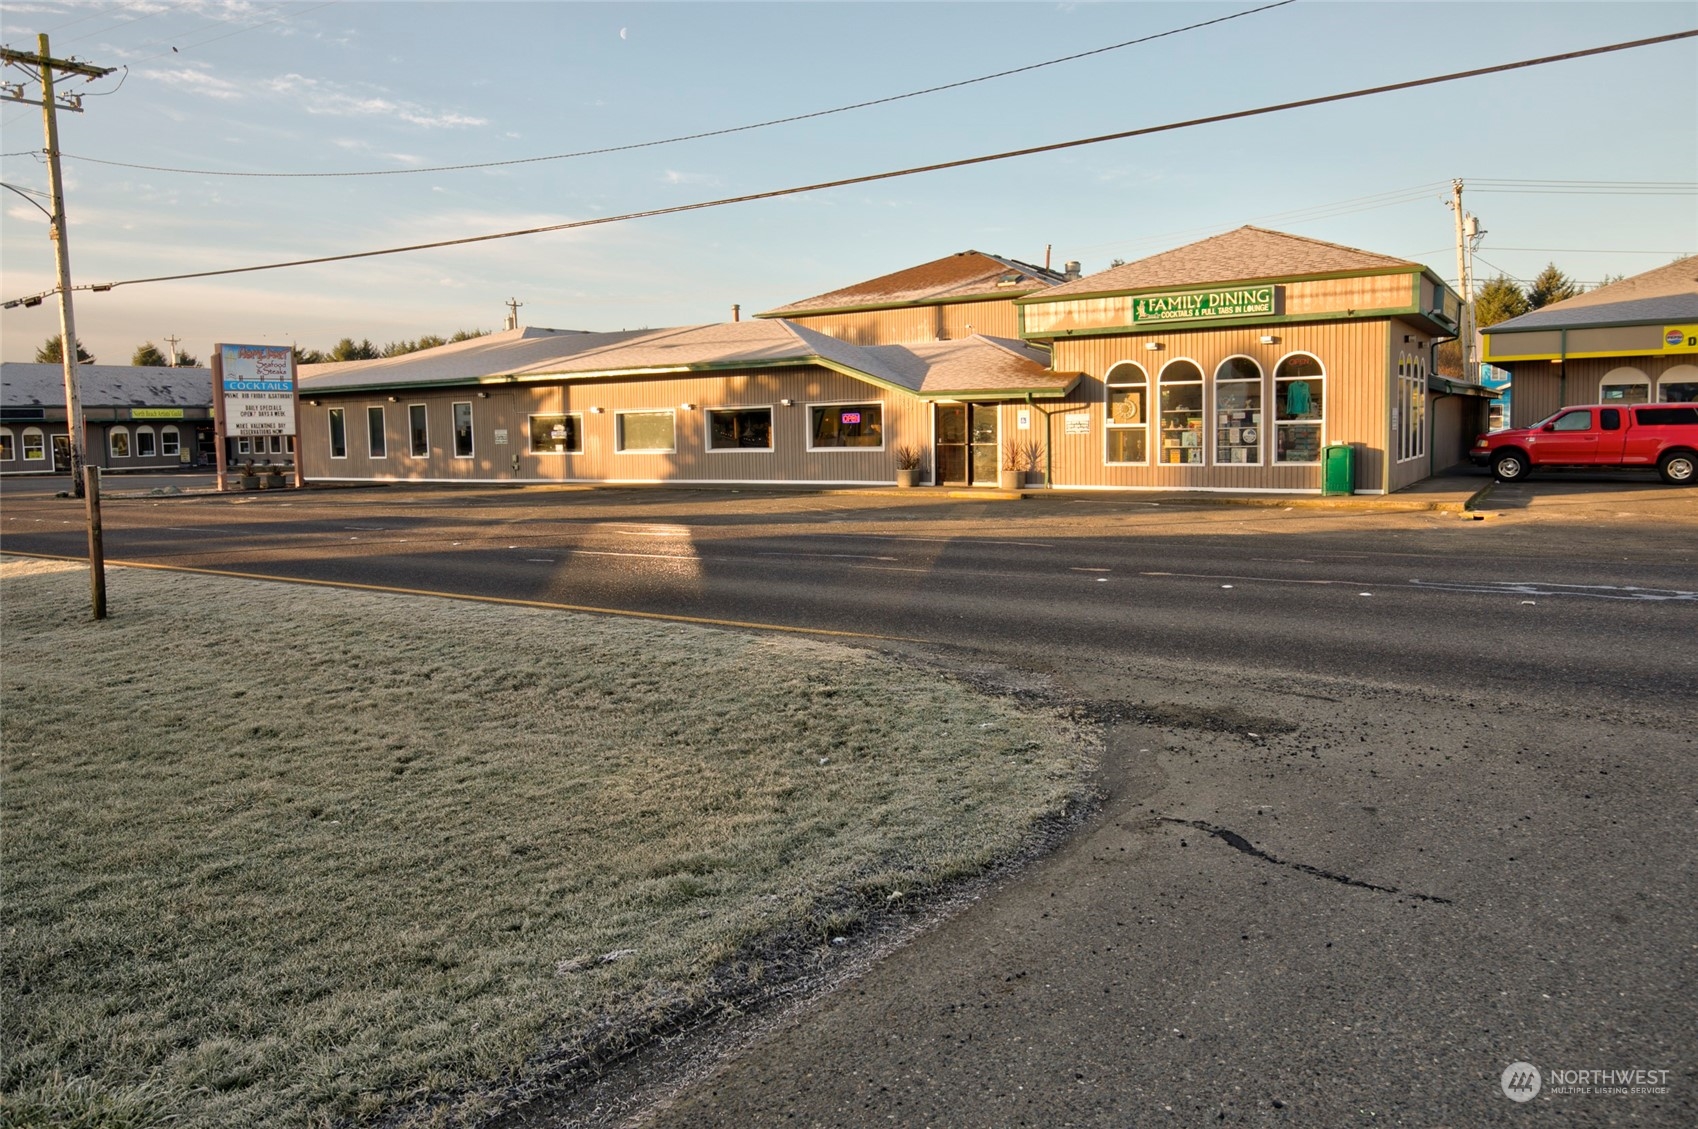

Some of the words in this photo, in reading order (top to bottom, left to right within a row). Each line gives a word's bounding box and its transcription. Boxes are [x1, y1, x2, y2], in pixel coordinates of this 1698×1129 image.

[1149, 295, 1204, 312] FAMILY
[1209, 289, 1269, 307] DINING
[1160, 310, 1193, 319] COCKTAILS
[1201, 308, 1216, 316] PULL
[1218, 307, 1233, 315] TABS
[1243, 304, 1269, 313] LOUNGE
[256, 360, 286, 368] Seafood
[229, 382, 289, 391] COCKTAILS
